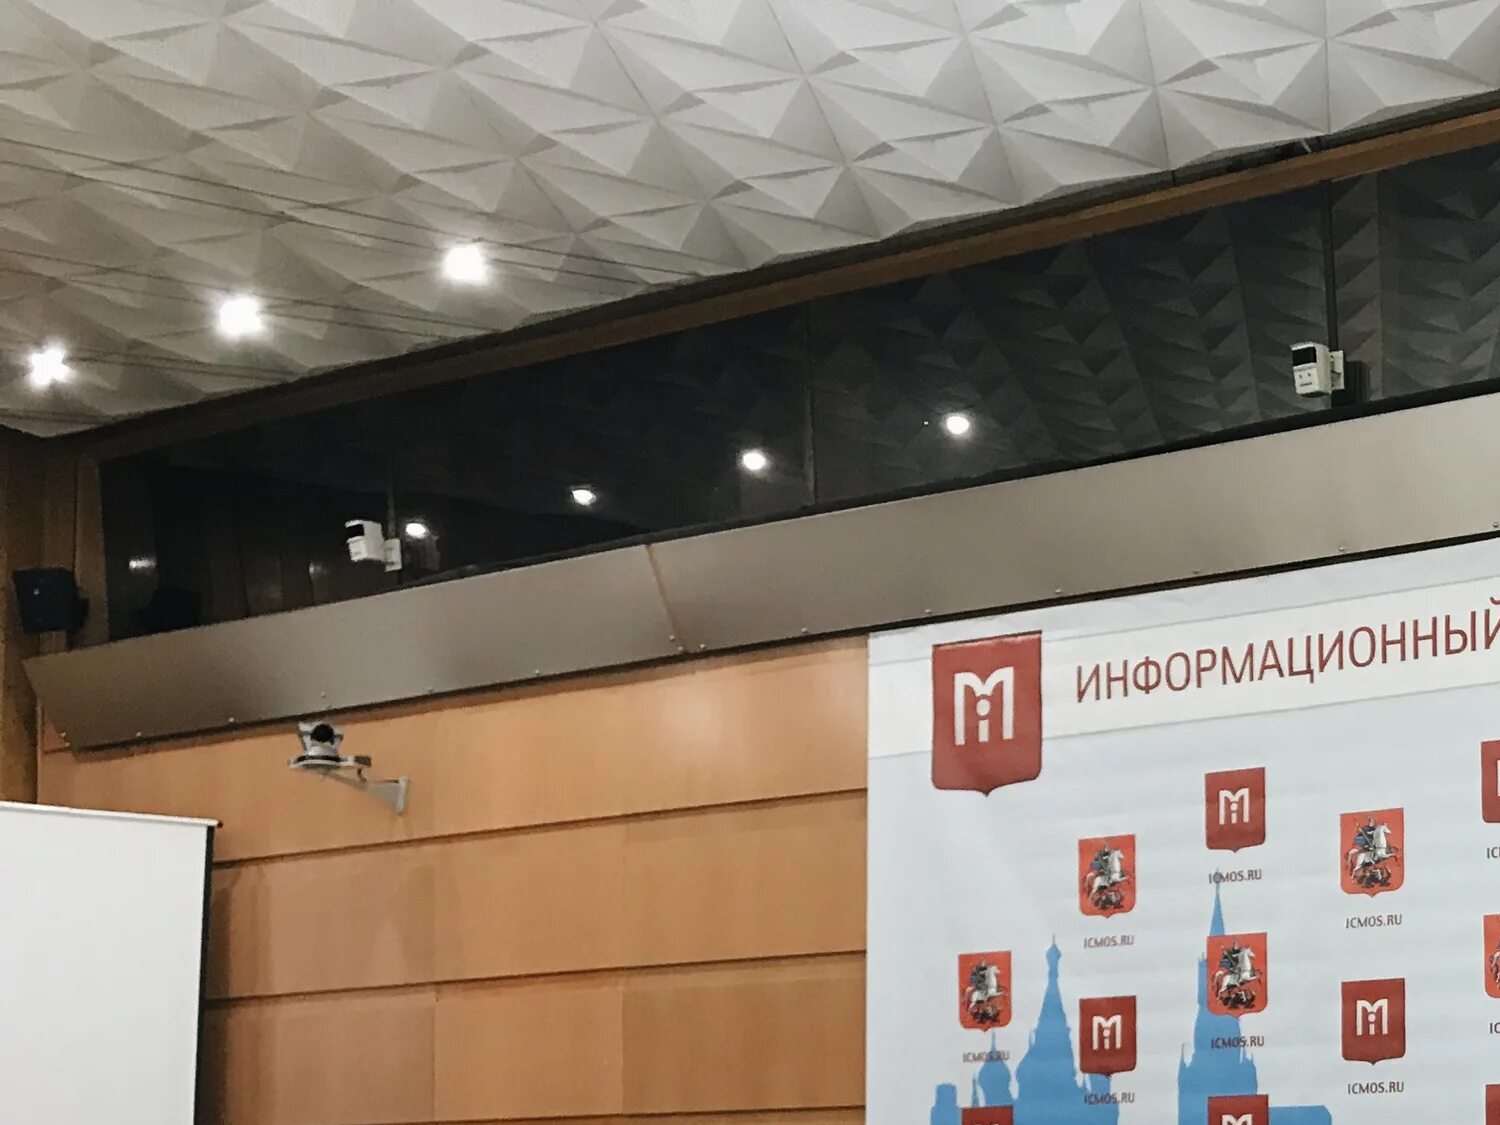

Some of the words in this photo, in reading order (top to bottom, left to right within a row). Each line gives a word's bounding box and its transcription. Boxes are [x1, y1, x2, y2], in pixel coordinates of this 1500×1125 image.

[1208, 869, 1262, 883] ICMOS.RU
[1346, 915, 1402, 928] ICMOS.RU
[1083, 935, 1135, 949] ICMOS.RU
[1211, 1036, 1265, 1049] ICMOS.RU
[963, 1050, 1010, 1063] ICMOS.RU
[1348, 1082, 1404, 1094] ICMOS.RU
[1084, 1092, 1136, 1105] ICMOS.RU
